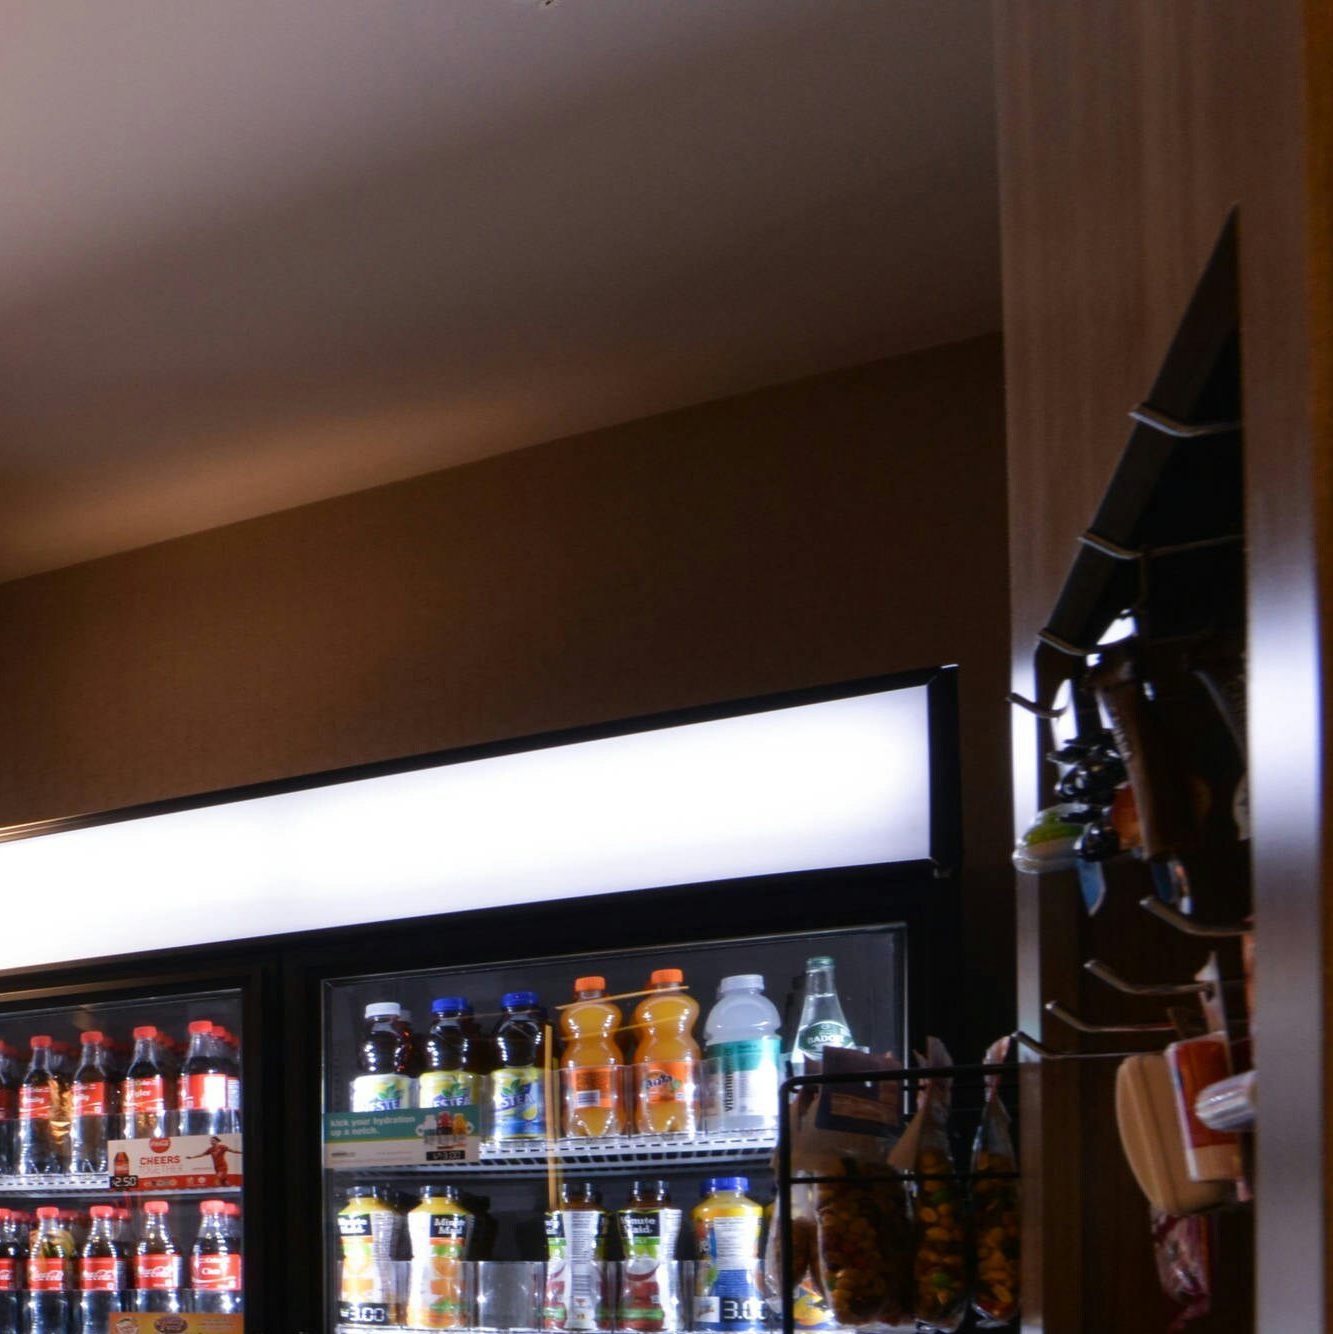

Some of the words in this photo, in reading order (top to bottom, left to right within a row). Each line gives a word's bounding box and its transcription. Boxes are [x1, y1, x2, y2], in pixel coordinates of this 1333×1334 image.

[351, 1119, 371, 1128] your
[373, 1115, 416, 1126] hydration
[139, 1156, 180, 1166] CHEERS
